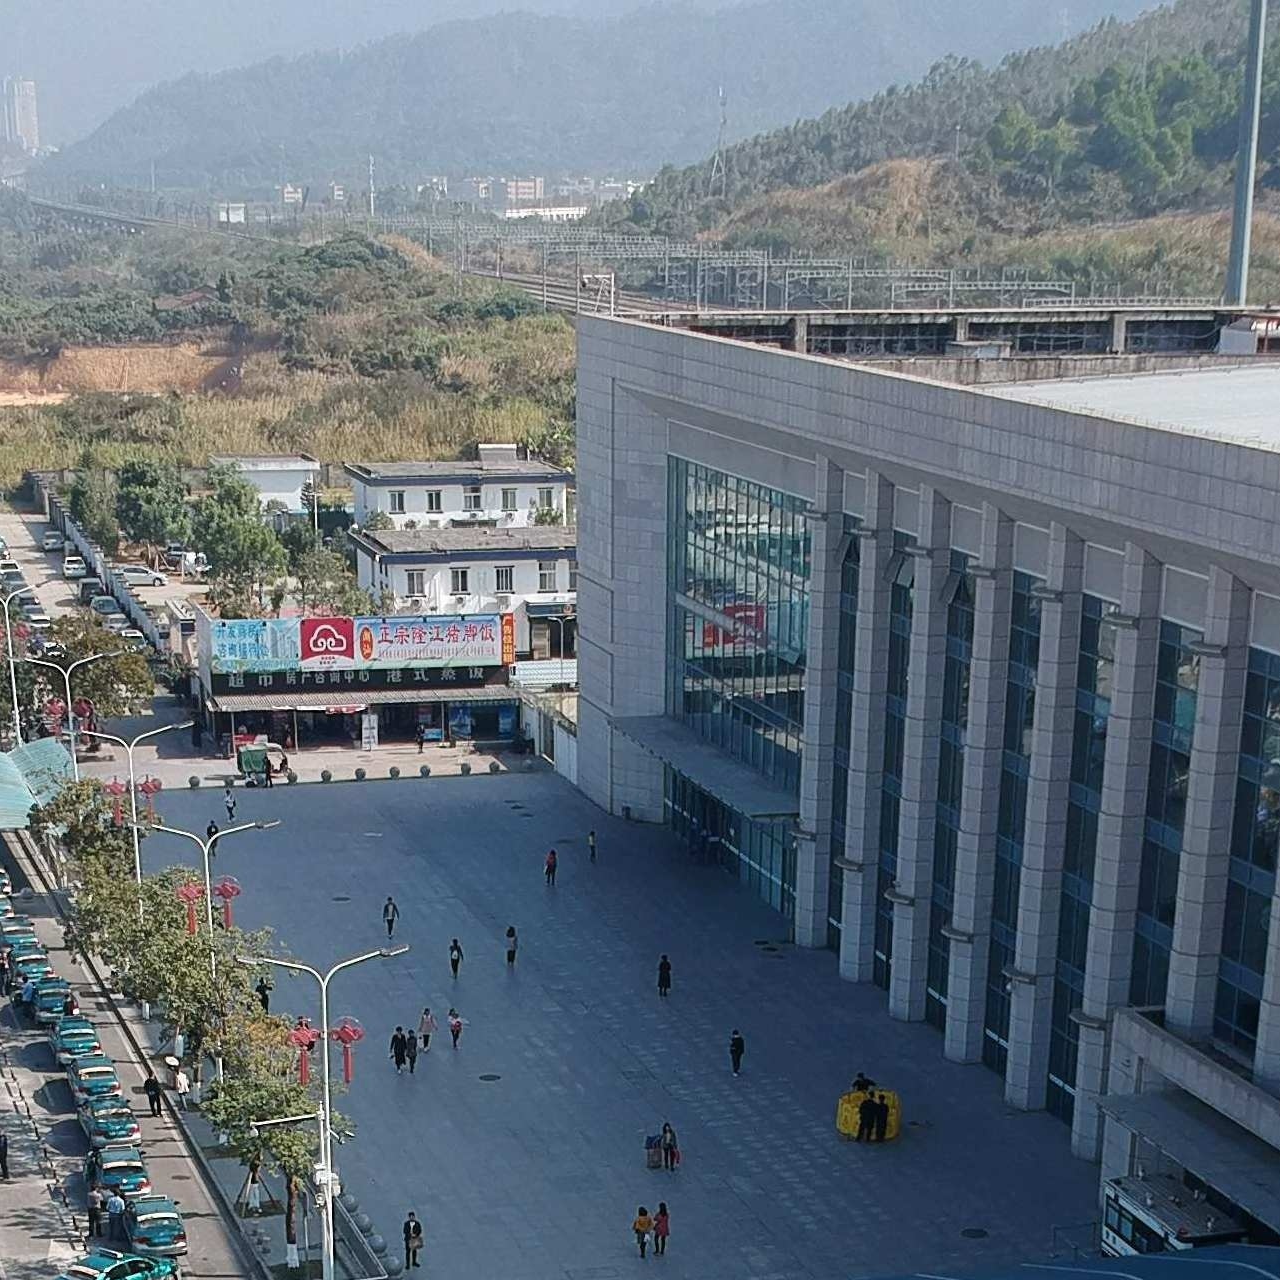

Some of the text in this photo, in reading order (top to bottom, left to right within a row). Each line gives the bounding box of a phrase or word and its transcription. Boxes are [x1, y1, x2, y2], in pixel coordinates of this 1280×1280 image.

[377, 623, 495, 645] 正宗隆江猪脚饭
[228, 672, 273, 688] 超市
[286, 670, 370, 685] 房产咨询中心
